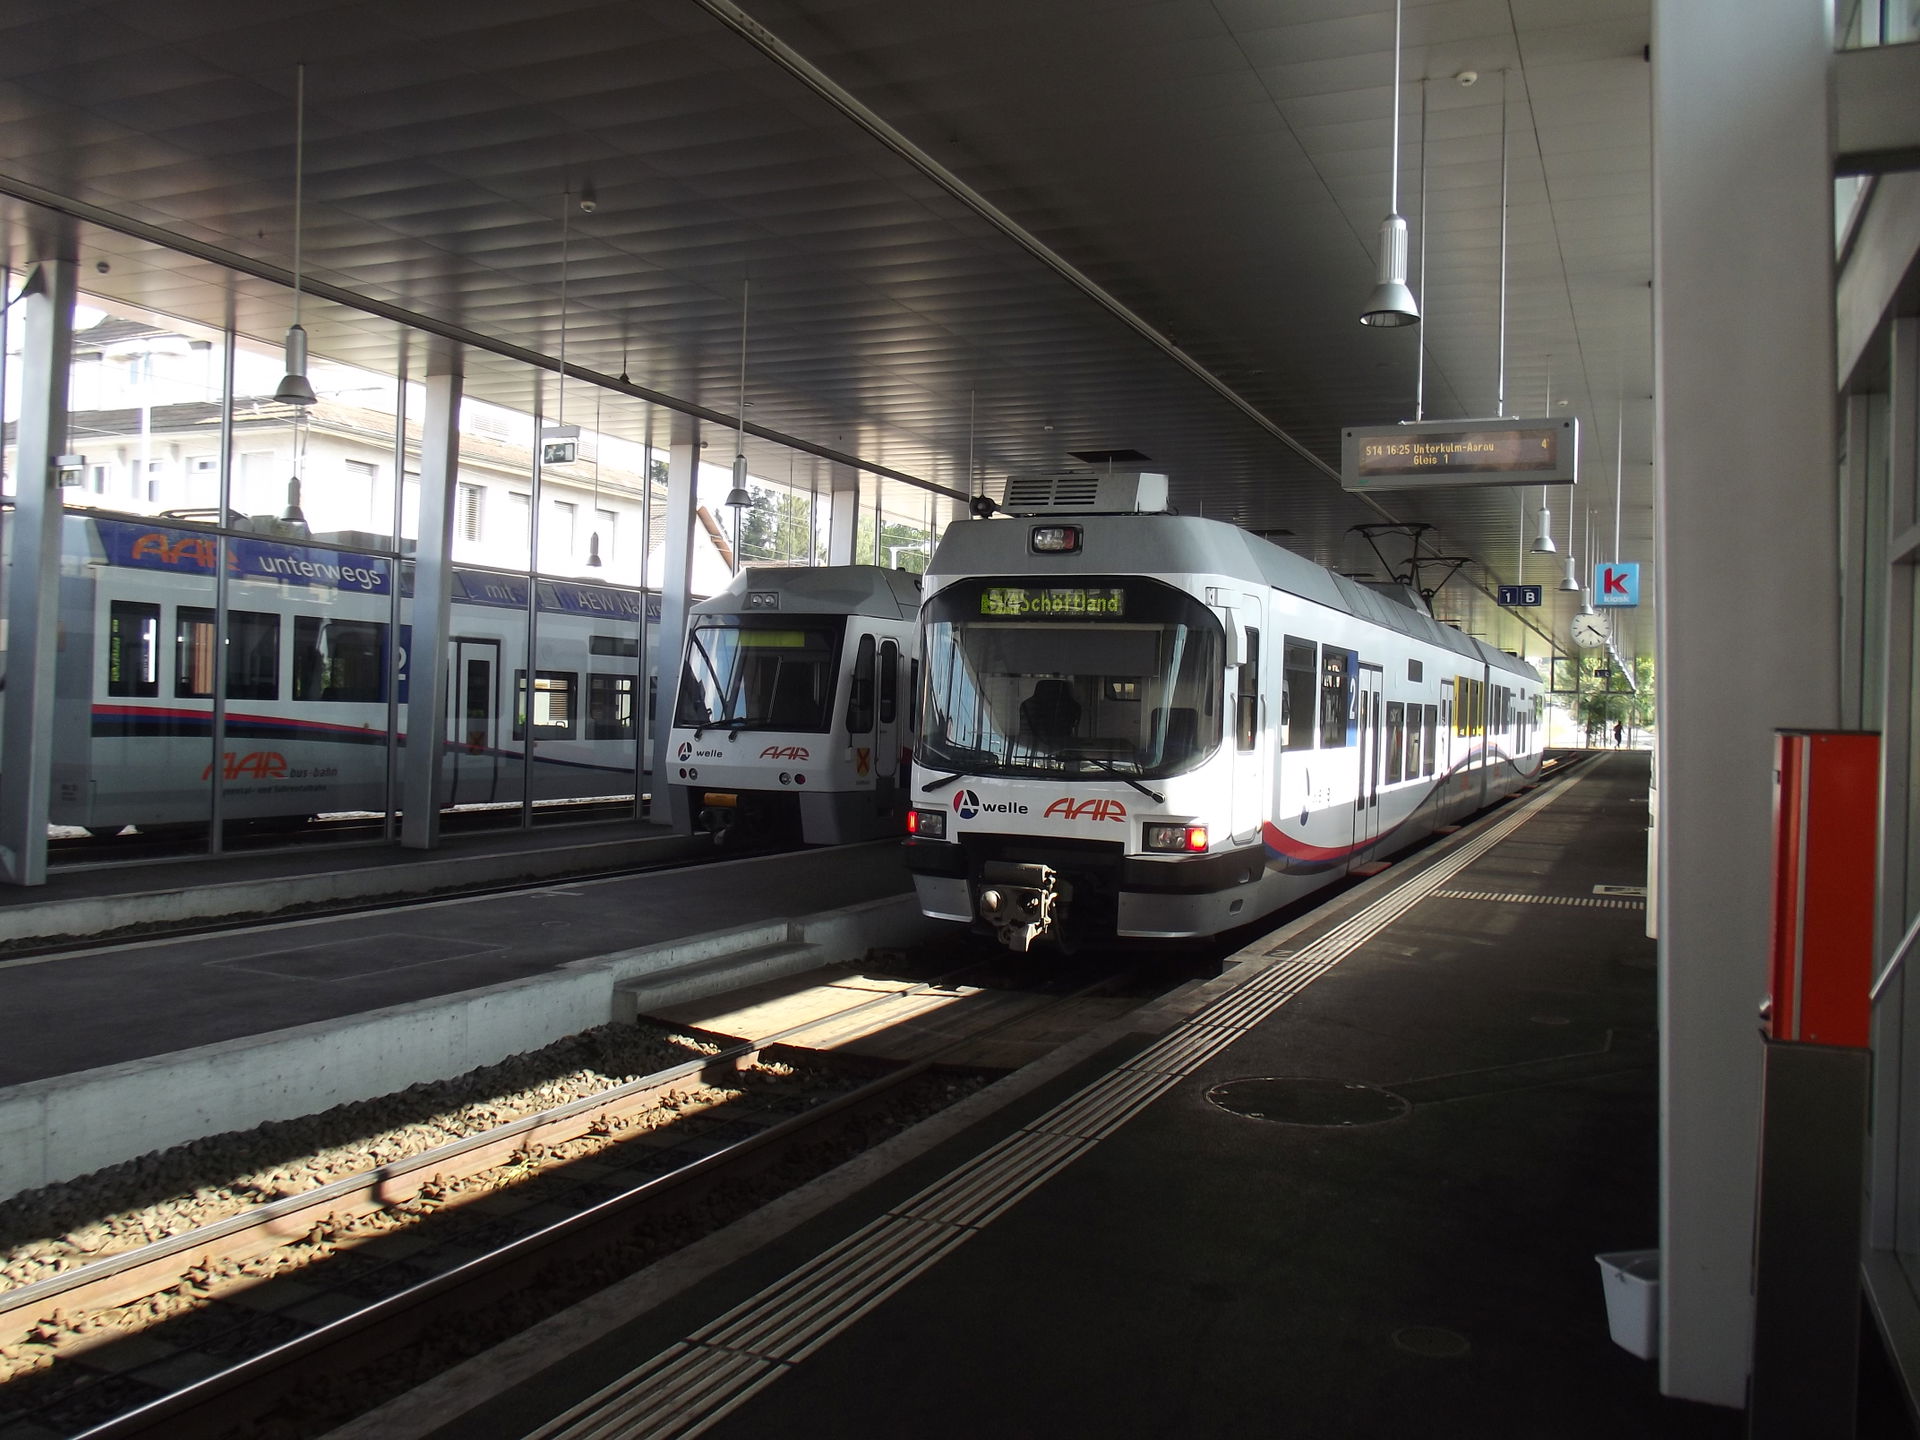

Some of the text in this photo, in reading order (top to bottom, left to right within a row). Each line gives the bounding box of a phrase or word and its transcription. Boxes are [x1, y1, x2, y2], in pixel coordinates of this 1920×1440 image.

[1365, 445, 1383, 455] S14
[1387, 444, 1410, 454] 16:25
[1413, 442, 1494, 455] Unterkulm-Aarau
[1413, 454, 1449, 465] Gleis 1
[259, 555, 381, 590] unterwegs
[579, 591, 615, 612] AEW
[1505, 592, 1511, 603] 1
[1525, 592, 1536, 603] B
[1348, 677, 1357, 720] 2
[696, 750, 723, 759] welle
[759, 746, 810, 762] AAR
[982, 802, 1029, 815] welle
[1043, 797, 1128, 823] AAR
